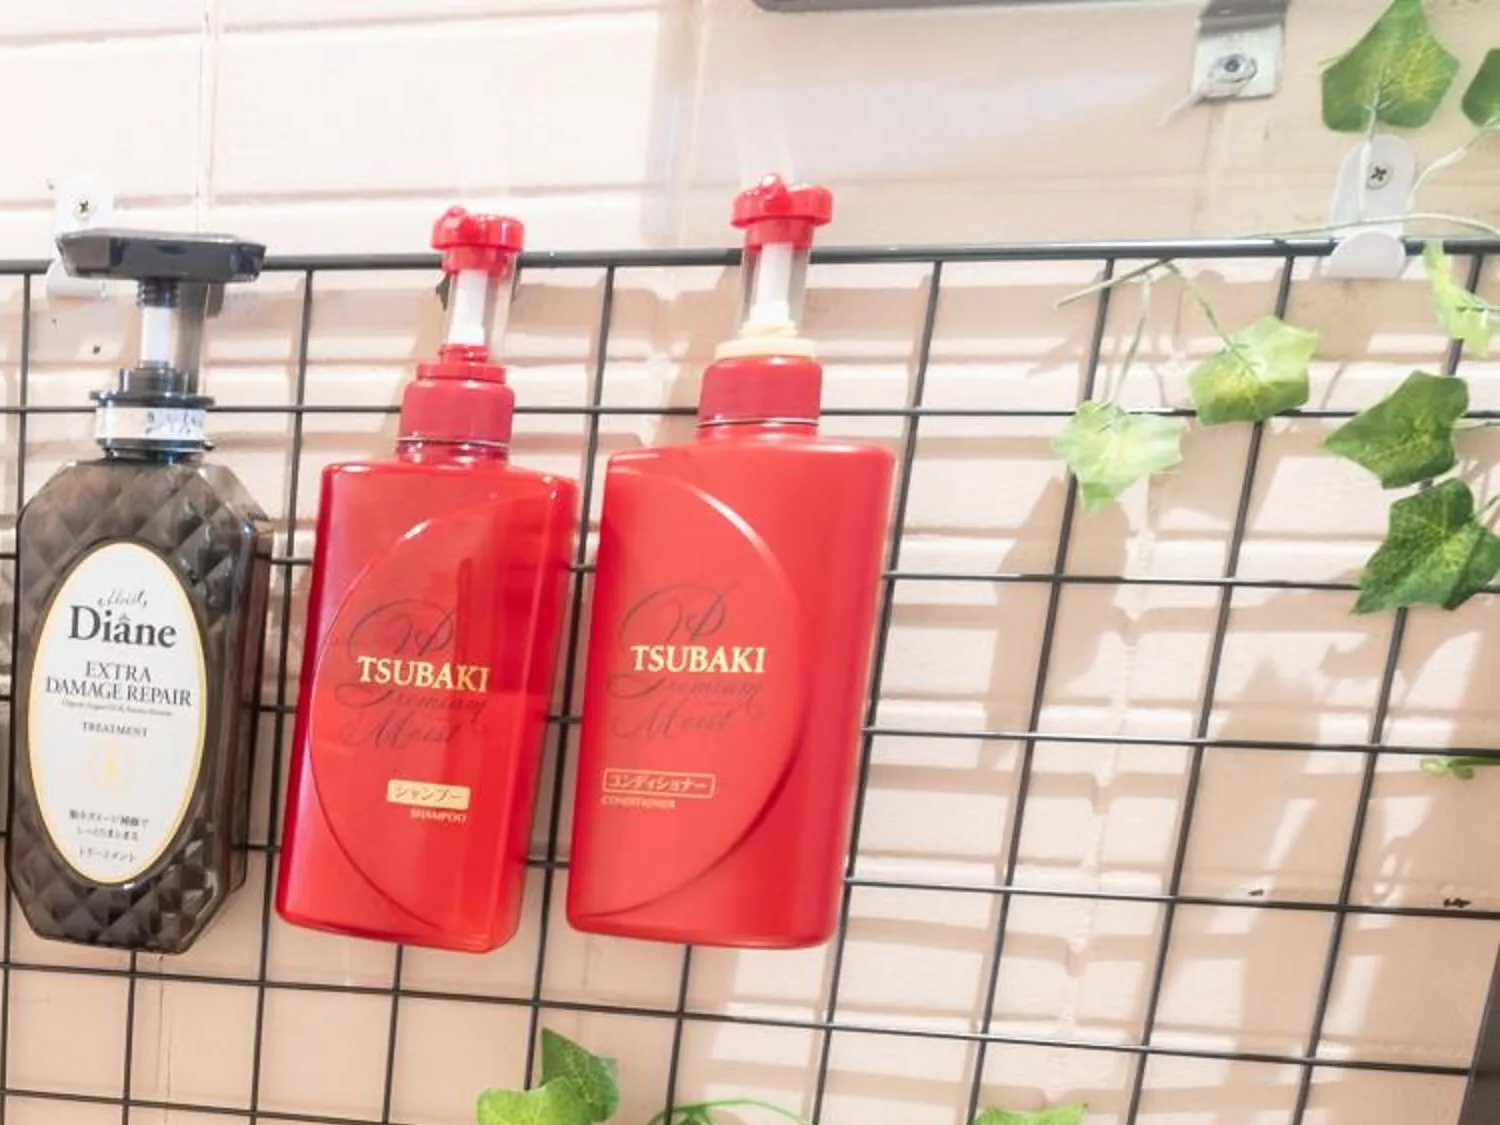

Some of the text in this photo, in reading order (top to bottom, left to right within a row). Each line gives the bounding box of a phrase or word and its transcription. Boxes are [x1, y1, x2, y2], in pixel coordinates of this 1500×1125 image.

[67, 603, 178, 649] Diâne
[630, 644, 768, 673] TSUBAKI
[84, 660, 152, 684] EXTRA
[356, 655, 493, 693] TSUBAKI
[45, 675, 192, 707] DAMAGE REPAIR
[82, 721, 148, 738] TREATMENT
[395, 785, 463, 803] シャンプー
[608, 773, 708, 793] コンディショナー
